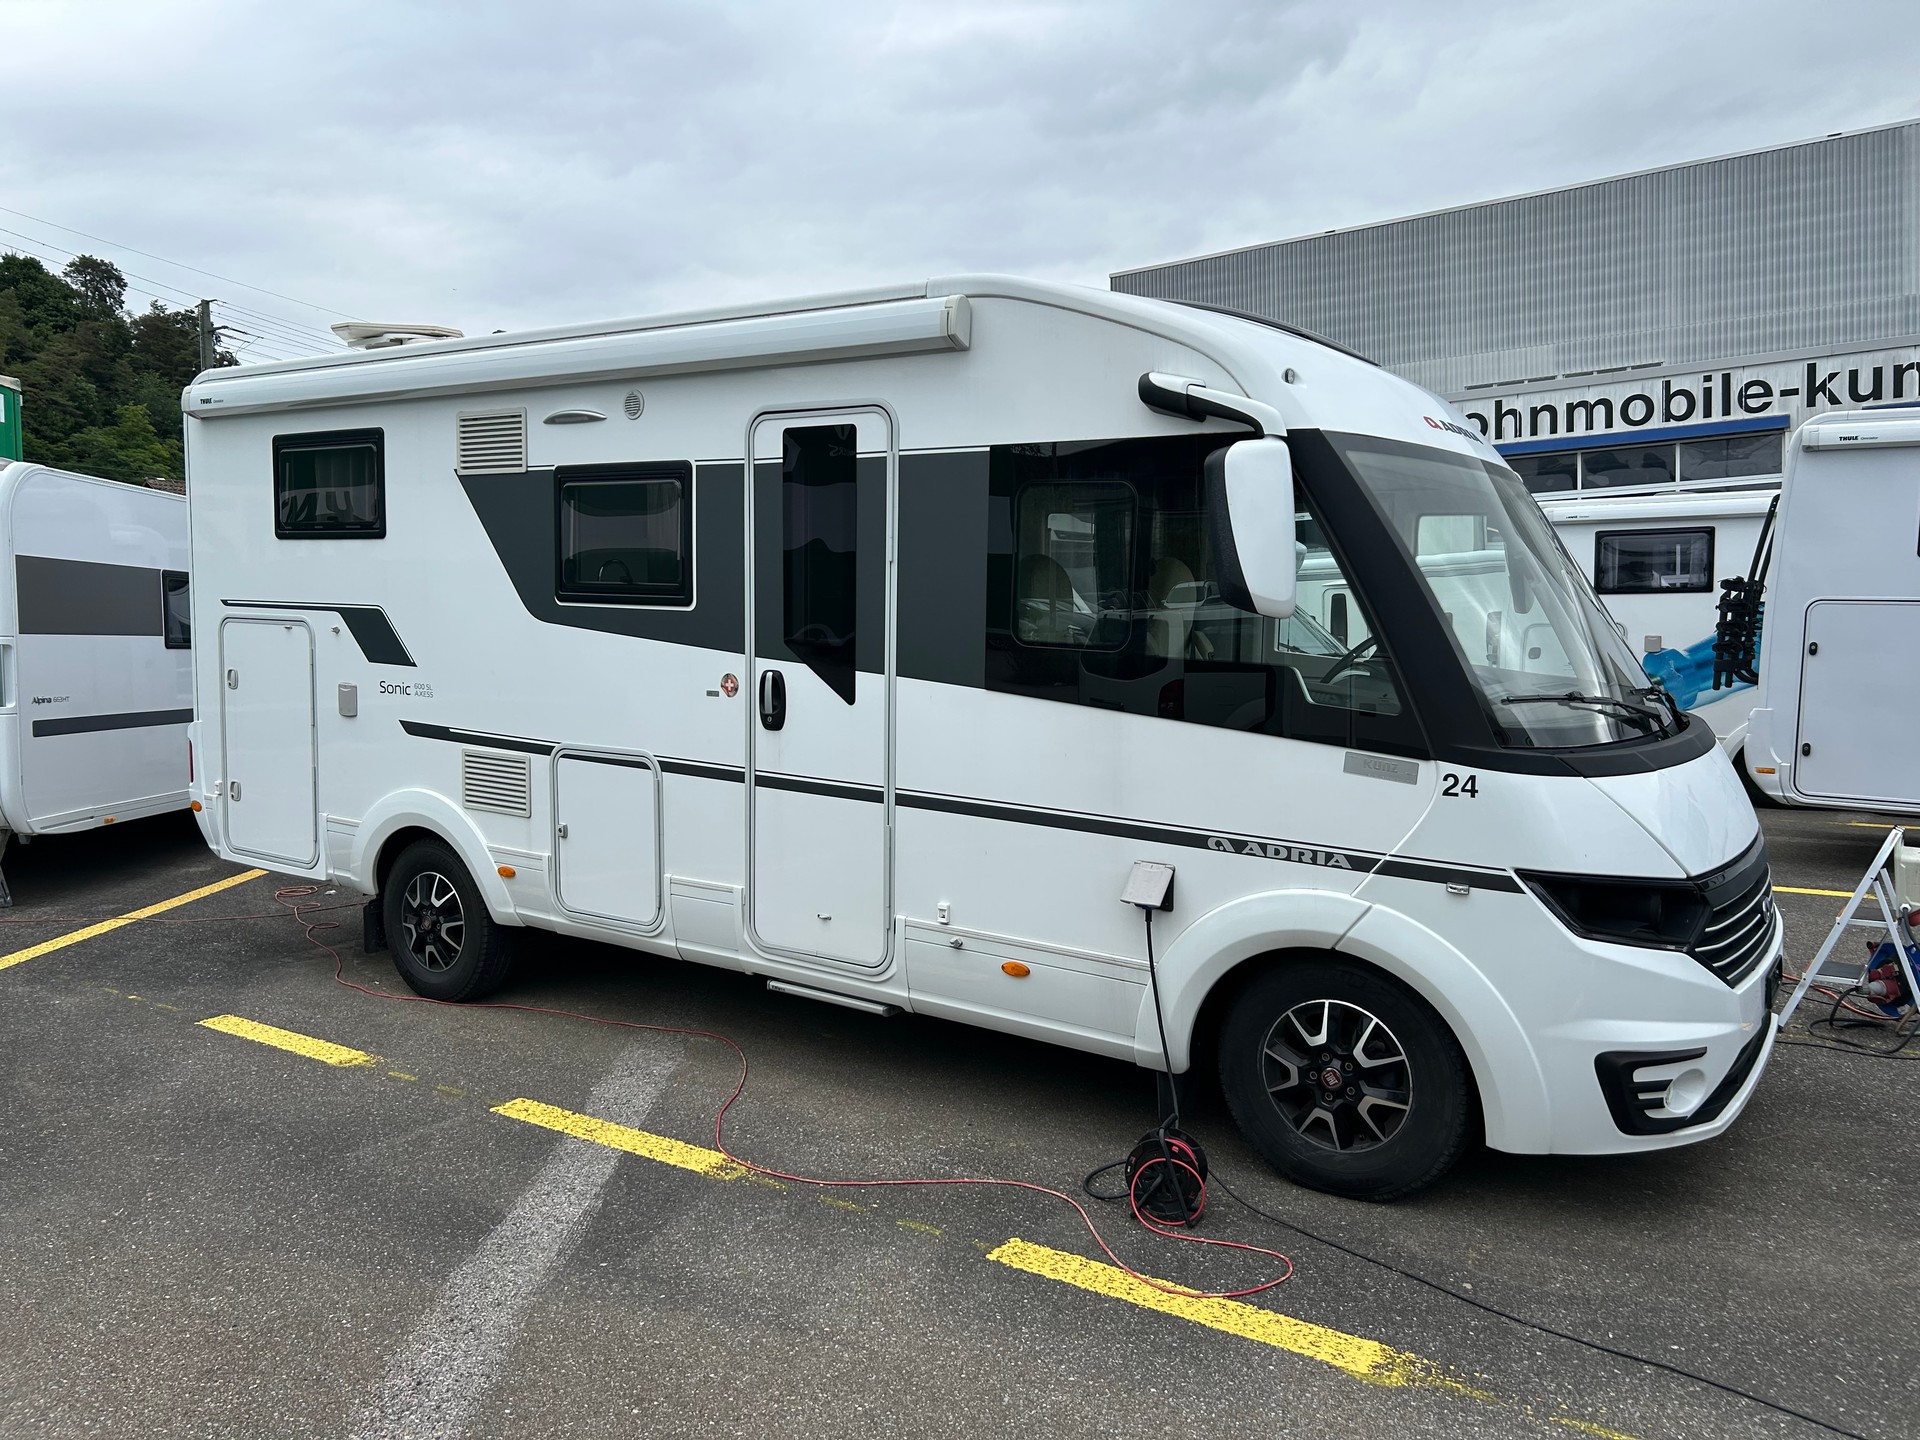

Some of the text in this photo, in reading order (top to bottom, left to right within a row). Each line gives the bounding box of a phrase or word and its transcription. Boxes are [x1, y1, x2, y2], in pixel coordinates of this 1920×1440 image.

[379, 680, 434, 696] Sonic 600 SL
[414, 690, 434, 699] AXESS
[31, 696, 52, 706] Alpina
[1441, 773, 1479, 799] 24
[1241, 841, 1353, 869] ADRIA
